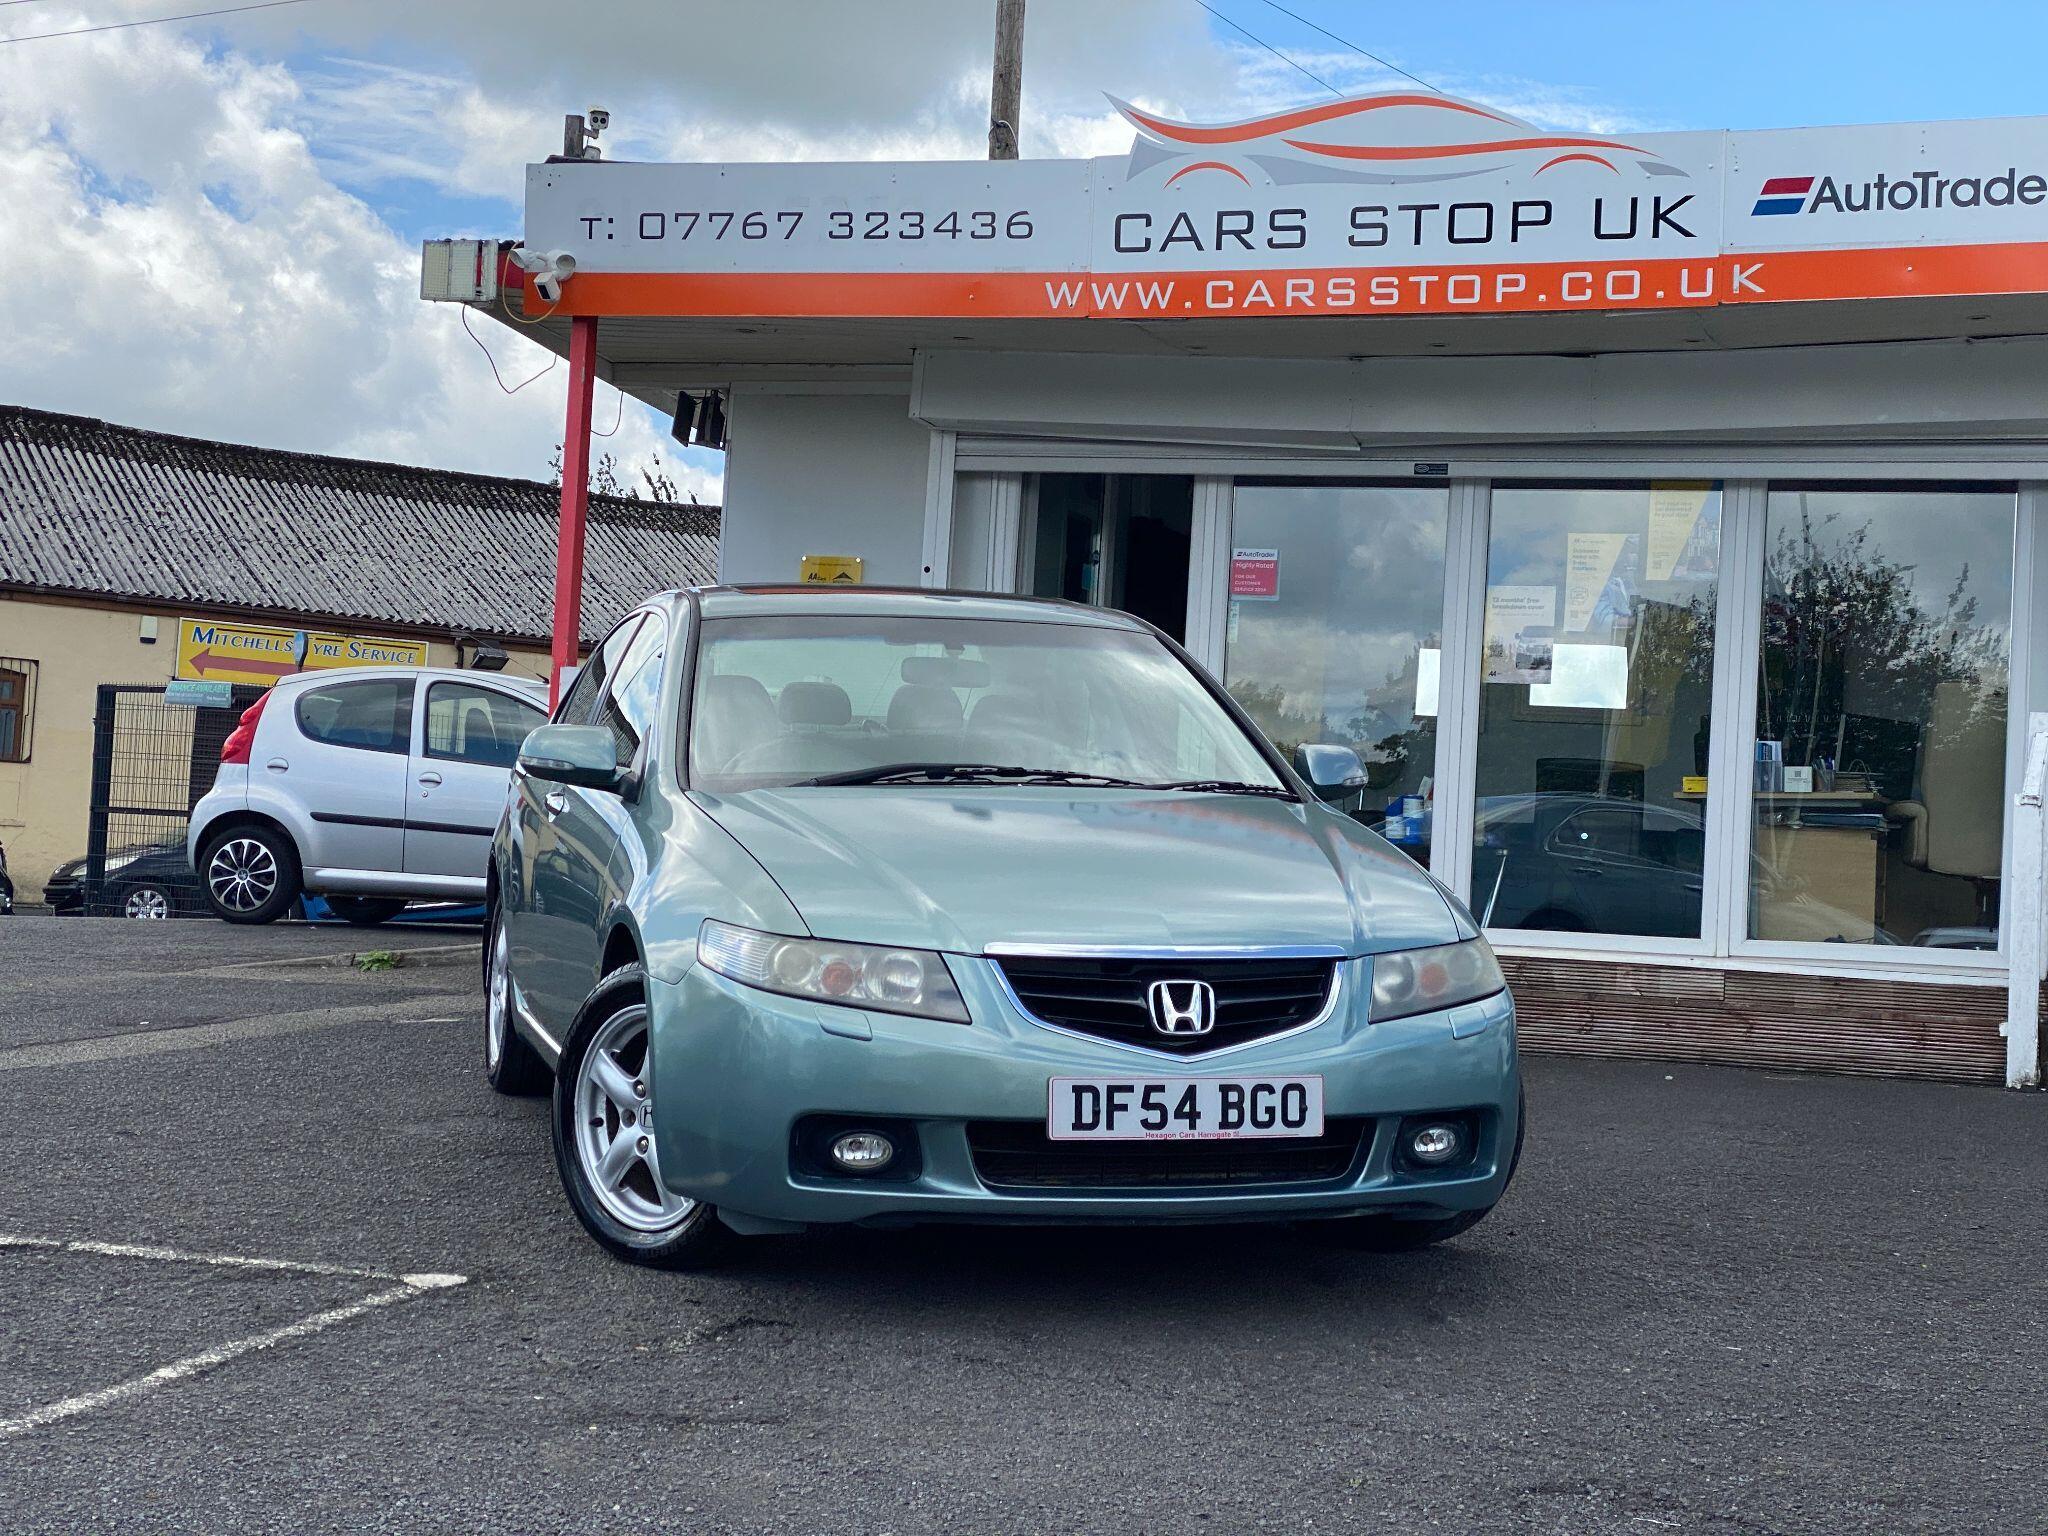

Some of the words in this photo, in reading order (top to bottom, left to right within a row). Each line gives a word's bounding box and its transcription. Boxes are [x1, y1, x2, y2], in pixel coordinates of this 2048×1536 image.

[580, 216, 615, 240] T:
[638, 210, 805, 241] 07767
[827, 210, 1035, 241] 323436
[1114, 208, 1307, 253] CARS
[1348, 199, 1554, 248] STOP
[1593, 194, 1698, 241] UK
[1045, 261, 1766, 311] WWW.CARSSTOP.CO.UK
[192, 626, 294, 653] MITCHELLS
[307, 637, 344, 657] YRE
[348, 641, 416, 665] SERVICE
[1071, 1083, 1202, 1132] DF54
[1218, 1082, 1308, 1130] BGO
[1145, 1132, 1177, 1140] Hexagon
[1179, 1131, 1196, 1139] Cars
[1198, 1131, 1232, 1140] Harrogate
